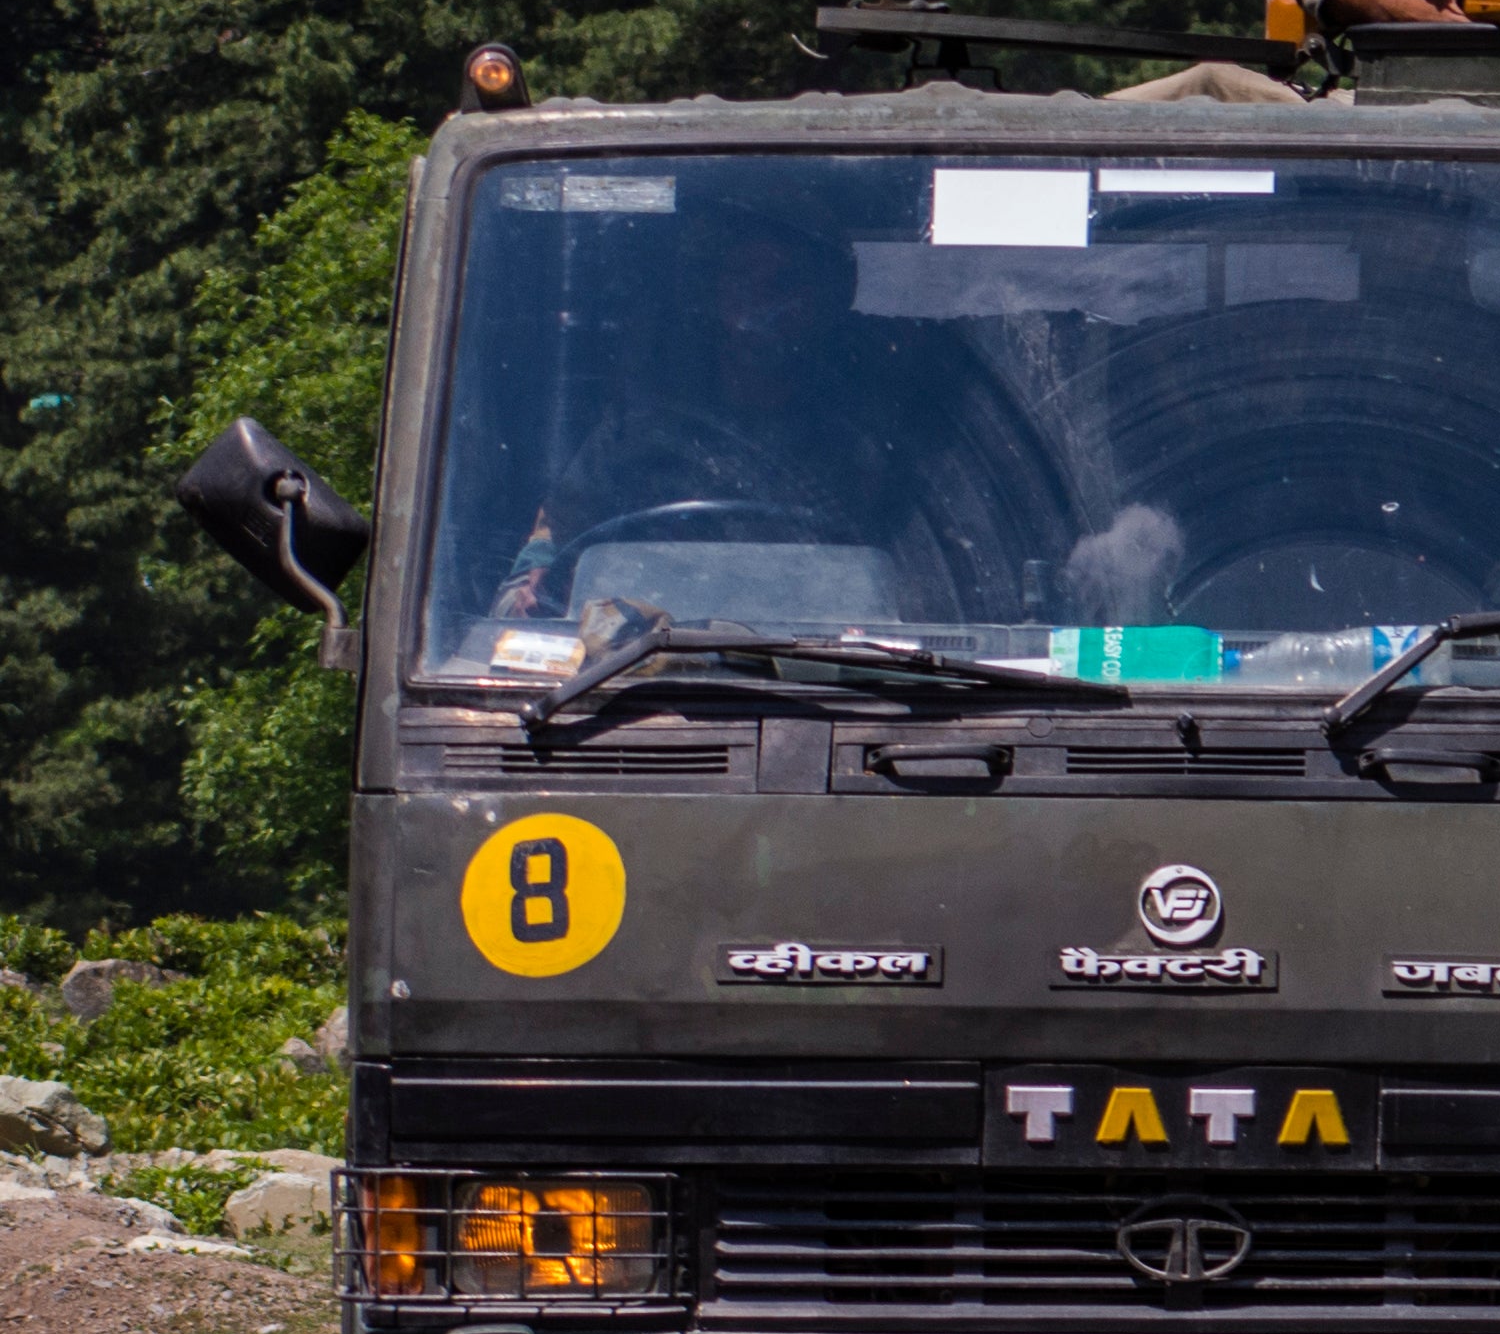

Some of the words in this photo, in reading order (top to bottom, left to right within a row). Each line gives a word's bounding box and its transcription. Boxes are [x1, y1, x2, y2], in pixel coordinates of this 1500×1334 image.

[510, 836, 570, 944] 8
[728, 943, 930, 978] व्हीकल
[1061, 946, 1266, 983] फैक्टरी
[1006, 1085, 1351, 1146] TATA
